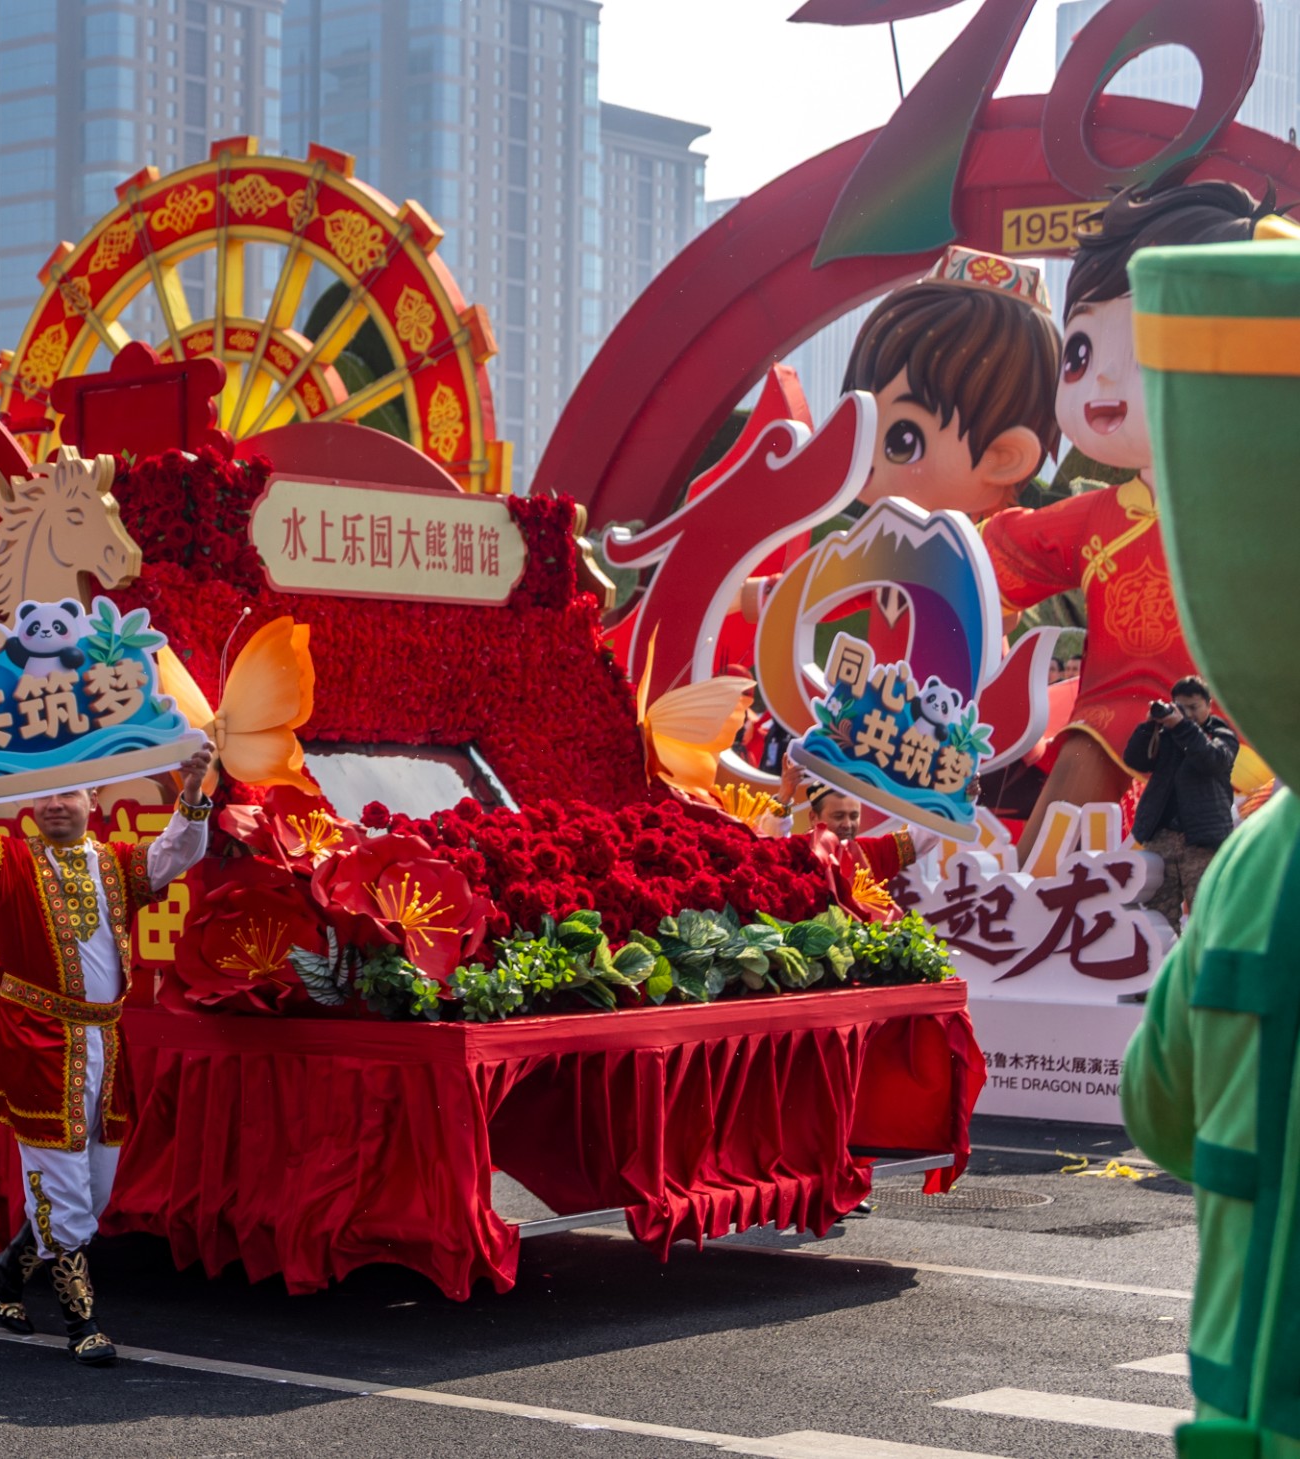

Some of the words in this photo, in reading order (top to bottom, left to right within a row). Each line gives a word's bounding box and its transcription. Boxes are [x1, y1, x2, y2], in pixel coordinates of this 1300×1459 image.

[281, 507, 500, 576] 水上乐园大熊猫馆
[827, 634, 917, 713] 同心
[854, 708, 976, 795] 共筑梦
[991, 1075, 1018, 1089] THE
[1021, 1077, 1081, 1094] DRAGON
